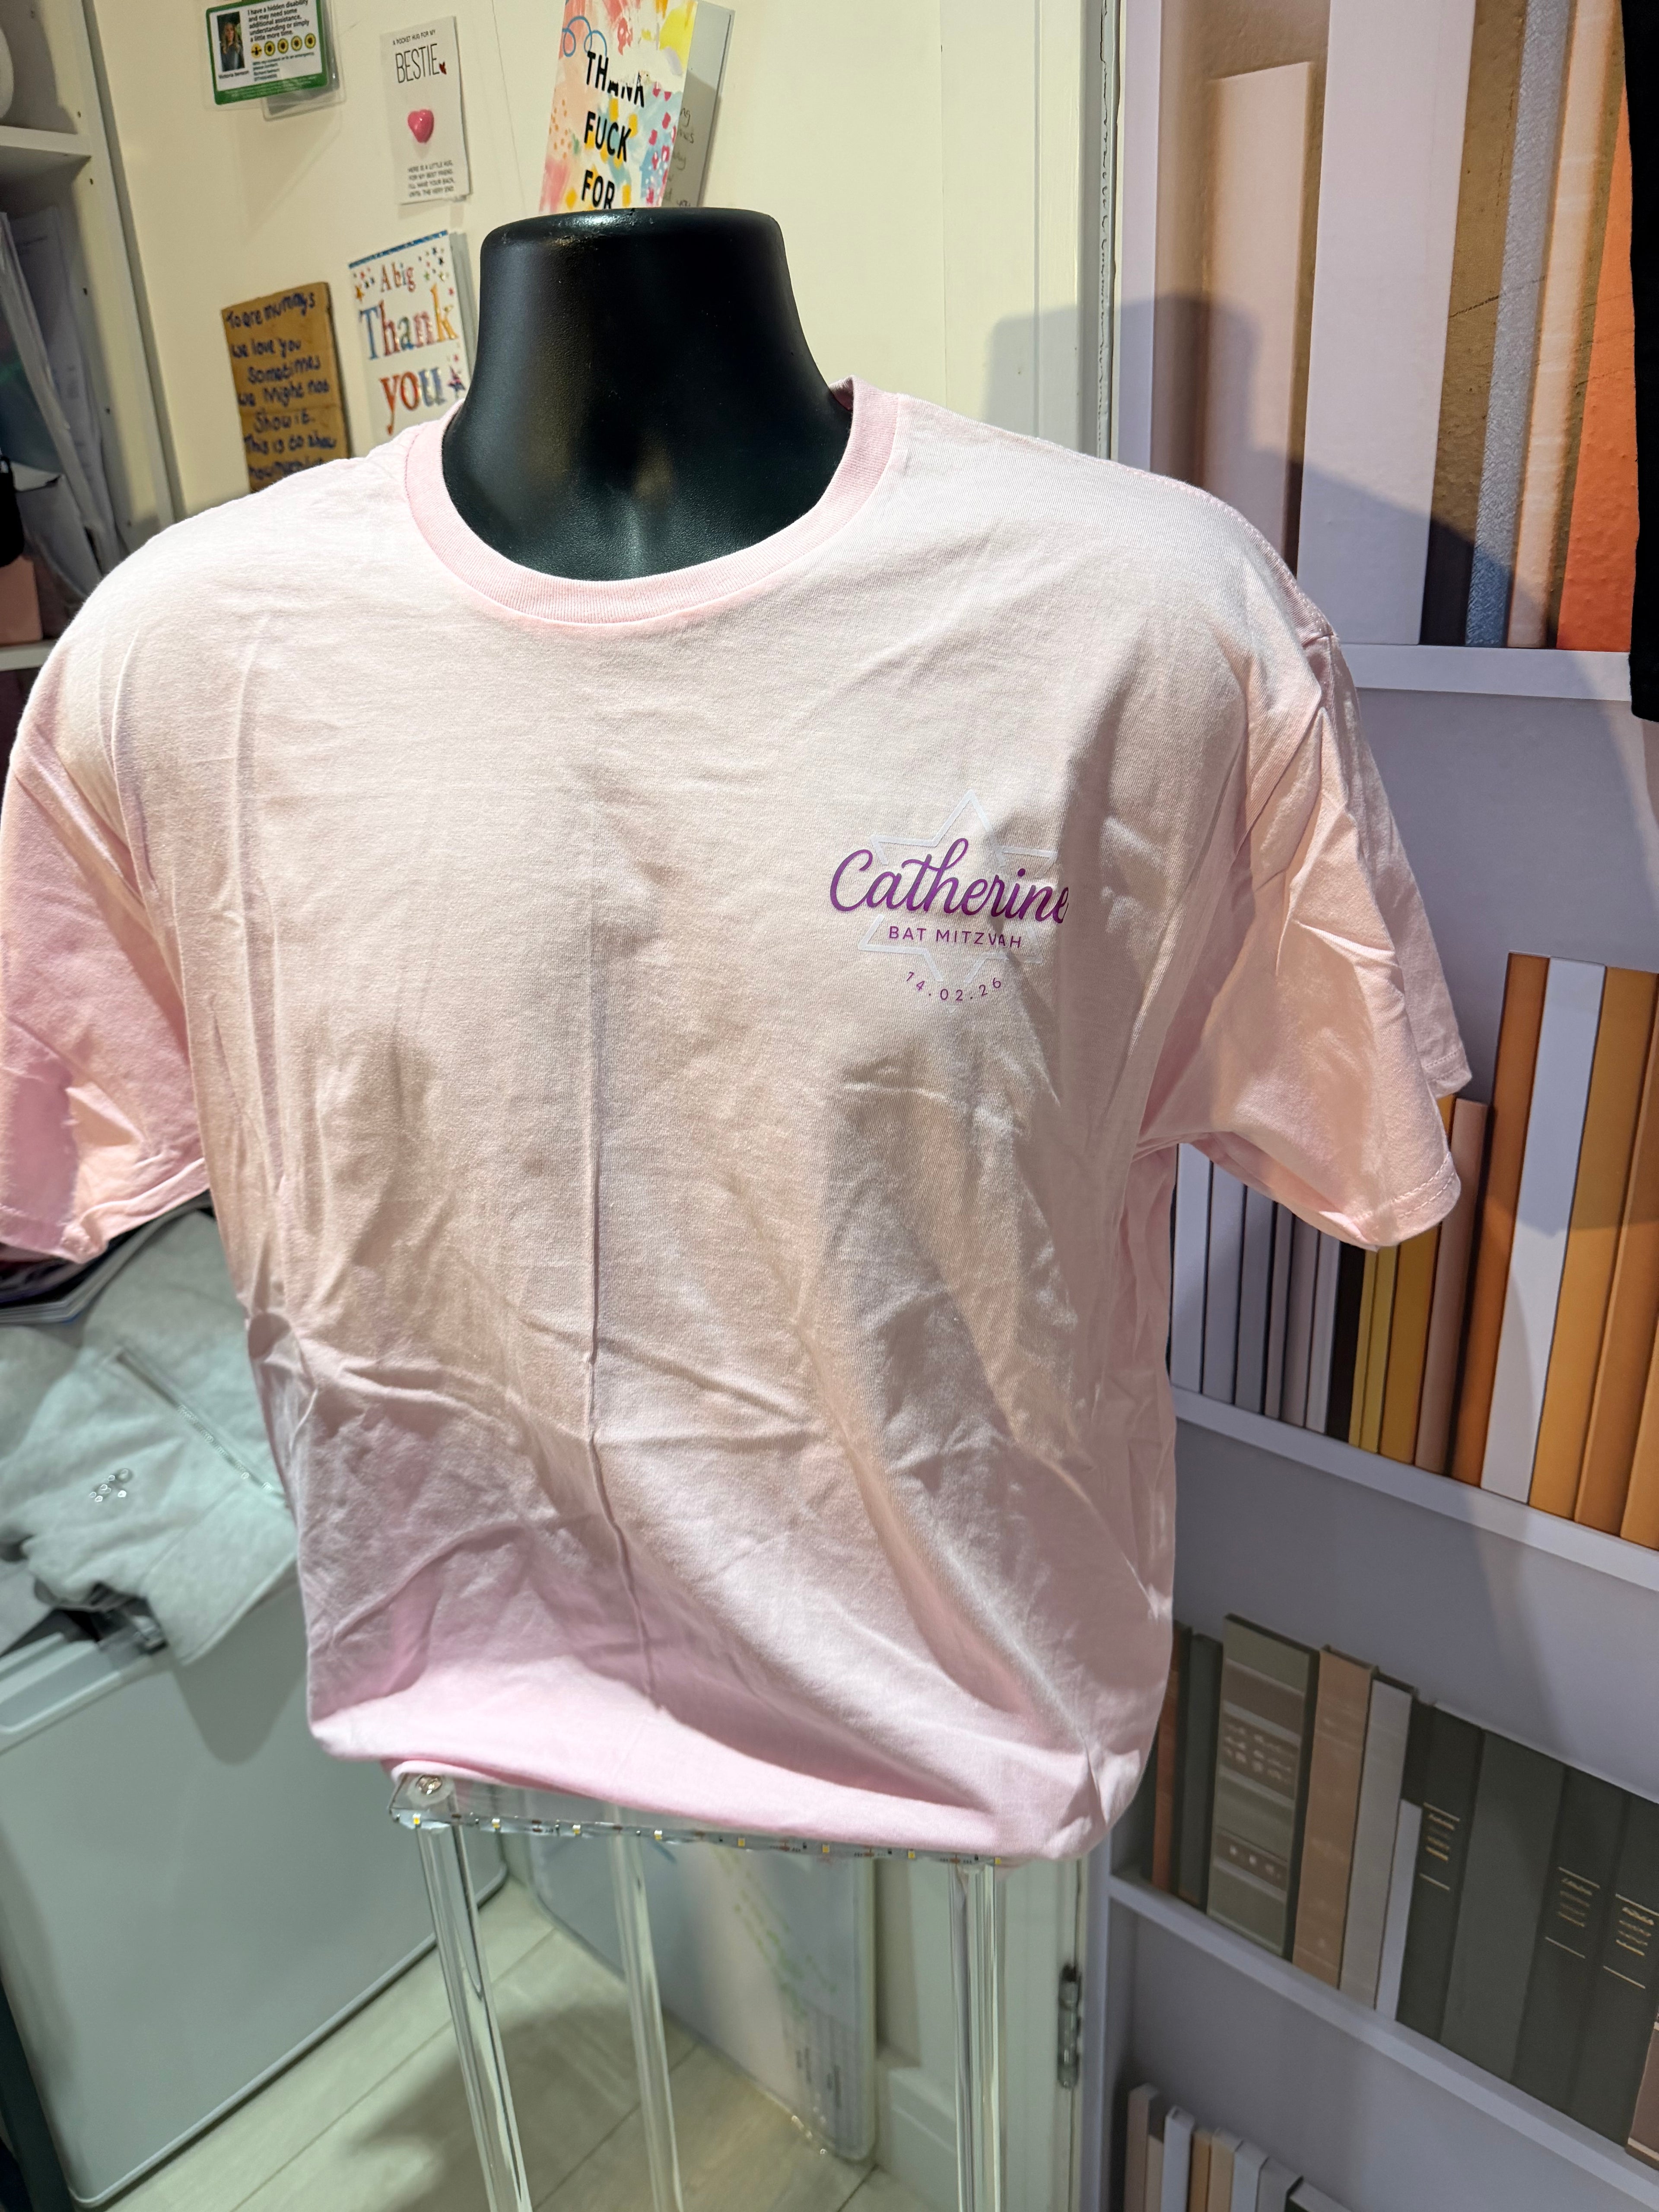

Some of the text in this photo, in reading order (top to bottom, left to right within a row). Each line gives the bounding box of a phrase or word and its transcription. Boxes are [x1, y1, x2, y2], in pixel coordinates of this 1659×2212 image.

[249, 19, 274, 29] additional
[250, 24, 286, 35] understanding
[396, 36, 410, 44] POCKET
[395, 43, 440, 83] BESTIE
[584, 111, 632, 162] FUCK
[582, 169, 615, 210] FOR
[380, 262, 416, 292] A big
[359, 283, 458, 360] Thank
[277, 338, 301, 359] you
[378, 366, 447, 436] you
[830, 838, 1069, 924] Catherine
[889, 926, 1022, 948] BAT MITZVAH
